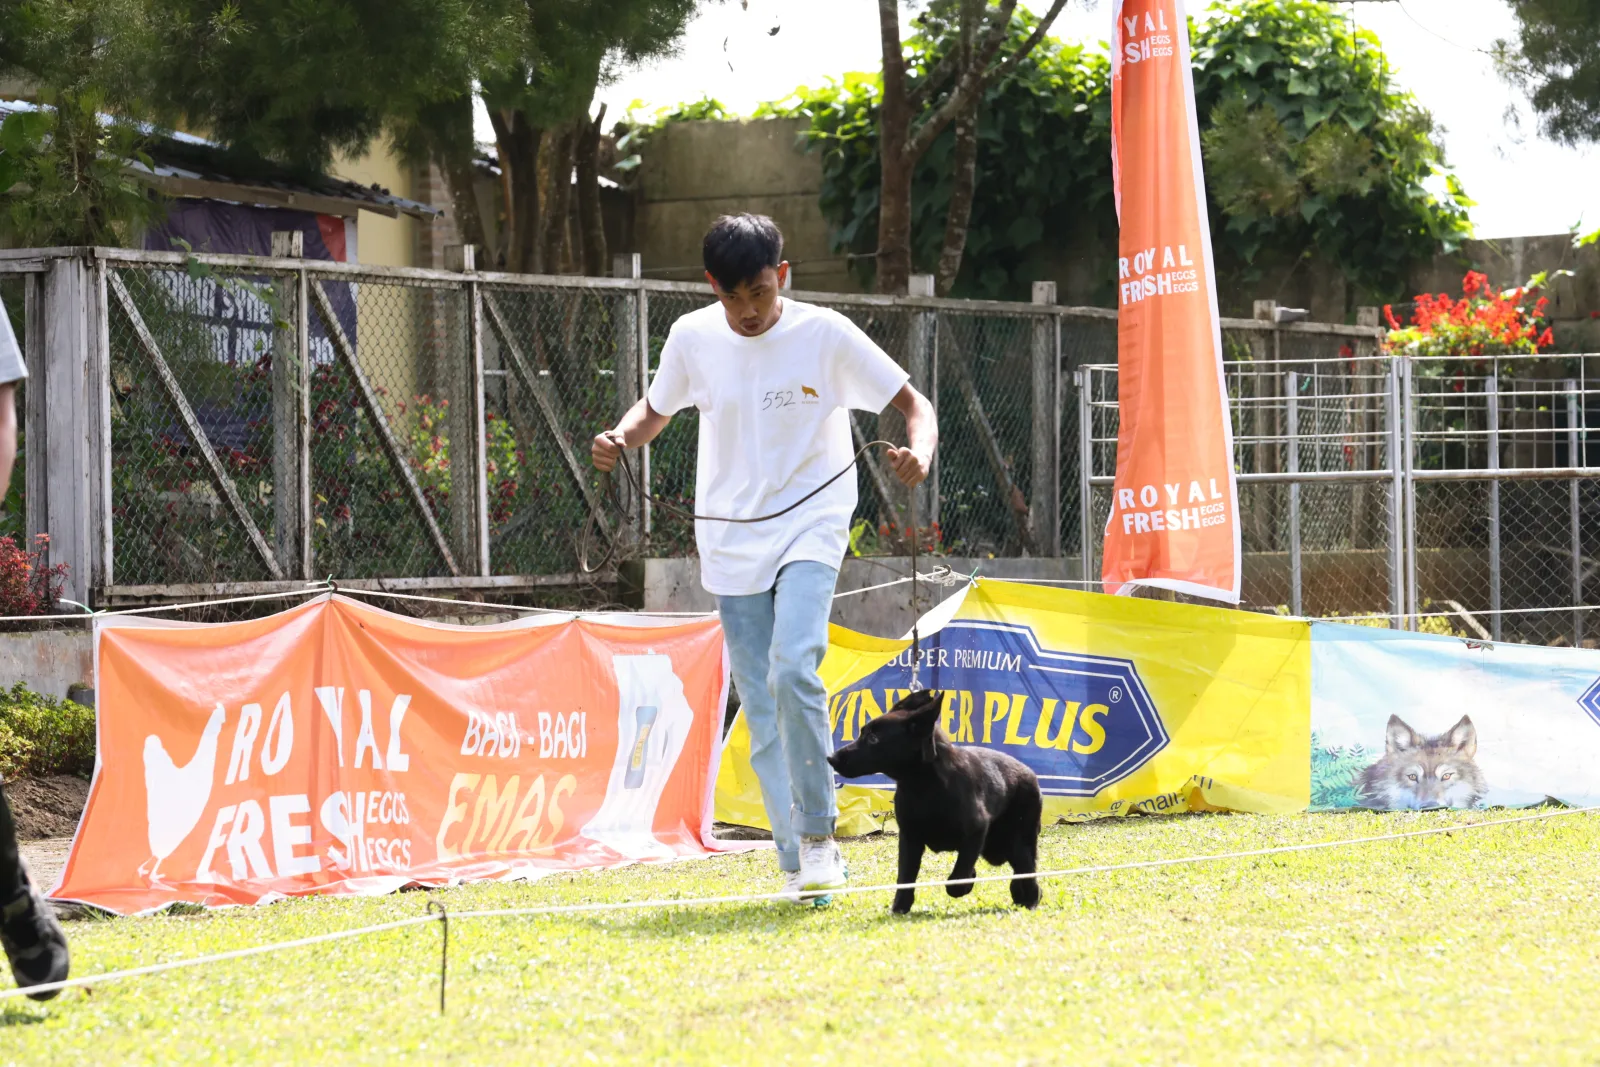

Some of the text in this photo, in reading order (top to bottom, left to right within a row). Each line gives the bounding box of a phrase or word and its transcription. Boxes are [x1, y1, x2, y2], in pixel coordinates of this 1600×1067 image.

[1123, 9, 1168, 37] YAL
[1150, 35, 1171, 45] EGGS
[1152, 47, 1173, 56] EGGS
[1119, 245, 1193, 279] ROYAL
[1172, 270, 1197, 281] EGGS
[1173, 282, 1198, 293] EGGS
[762, 390, 796, 410] 552
[1118, 478, 1223, 510] ROYAL
[1122, 508, 1200, 534] FRESH
[1200, 502, 1225, 515] EGGS
[1202, 514, 1226, 527] EGGS
[954, 649, 1021, 673] PREMIUM
[826, 688, 974, 743] WINER
[982, 690, 1110, 755] PLUS
[224, 686, 412, 785] ROYAL
[366, 791, 410, 824] EGGS
[436, 772, 577, 862] EMAS
[196, 791, 369, 883] FRESH
